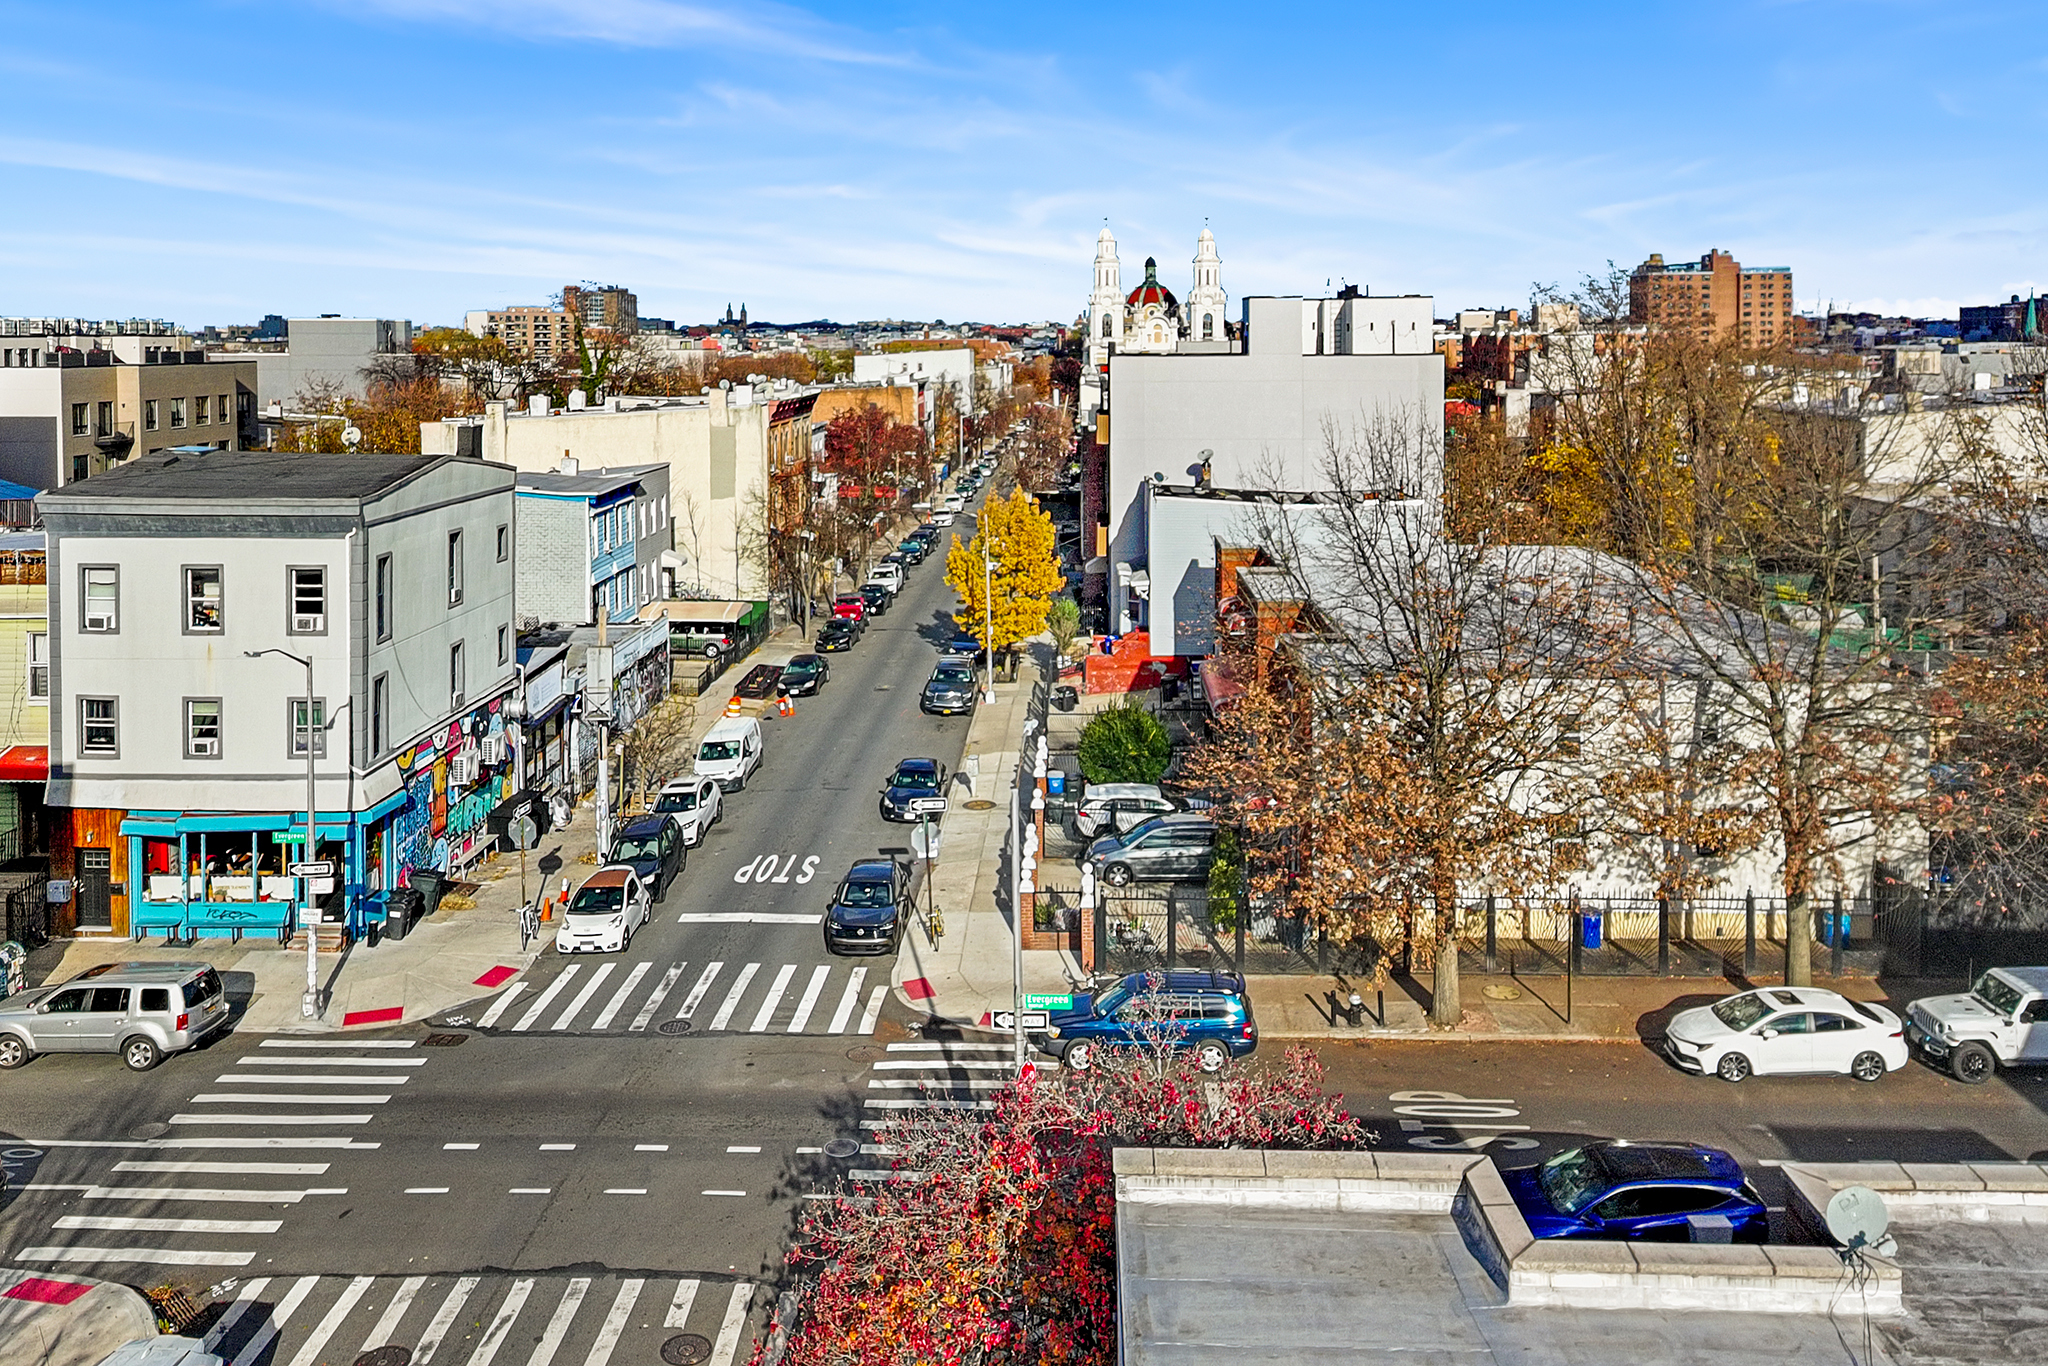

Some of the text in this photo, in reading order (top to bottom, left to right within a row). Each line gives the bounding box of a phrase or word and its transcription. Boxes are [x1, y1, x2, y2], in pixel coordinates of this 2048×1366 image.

[733, 854, 821, 884] STOP
[1027, 995, 1069, 1005] Evergreen
[1389, 1090, 1541, 1149] STOP
